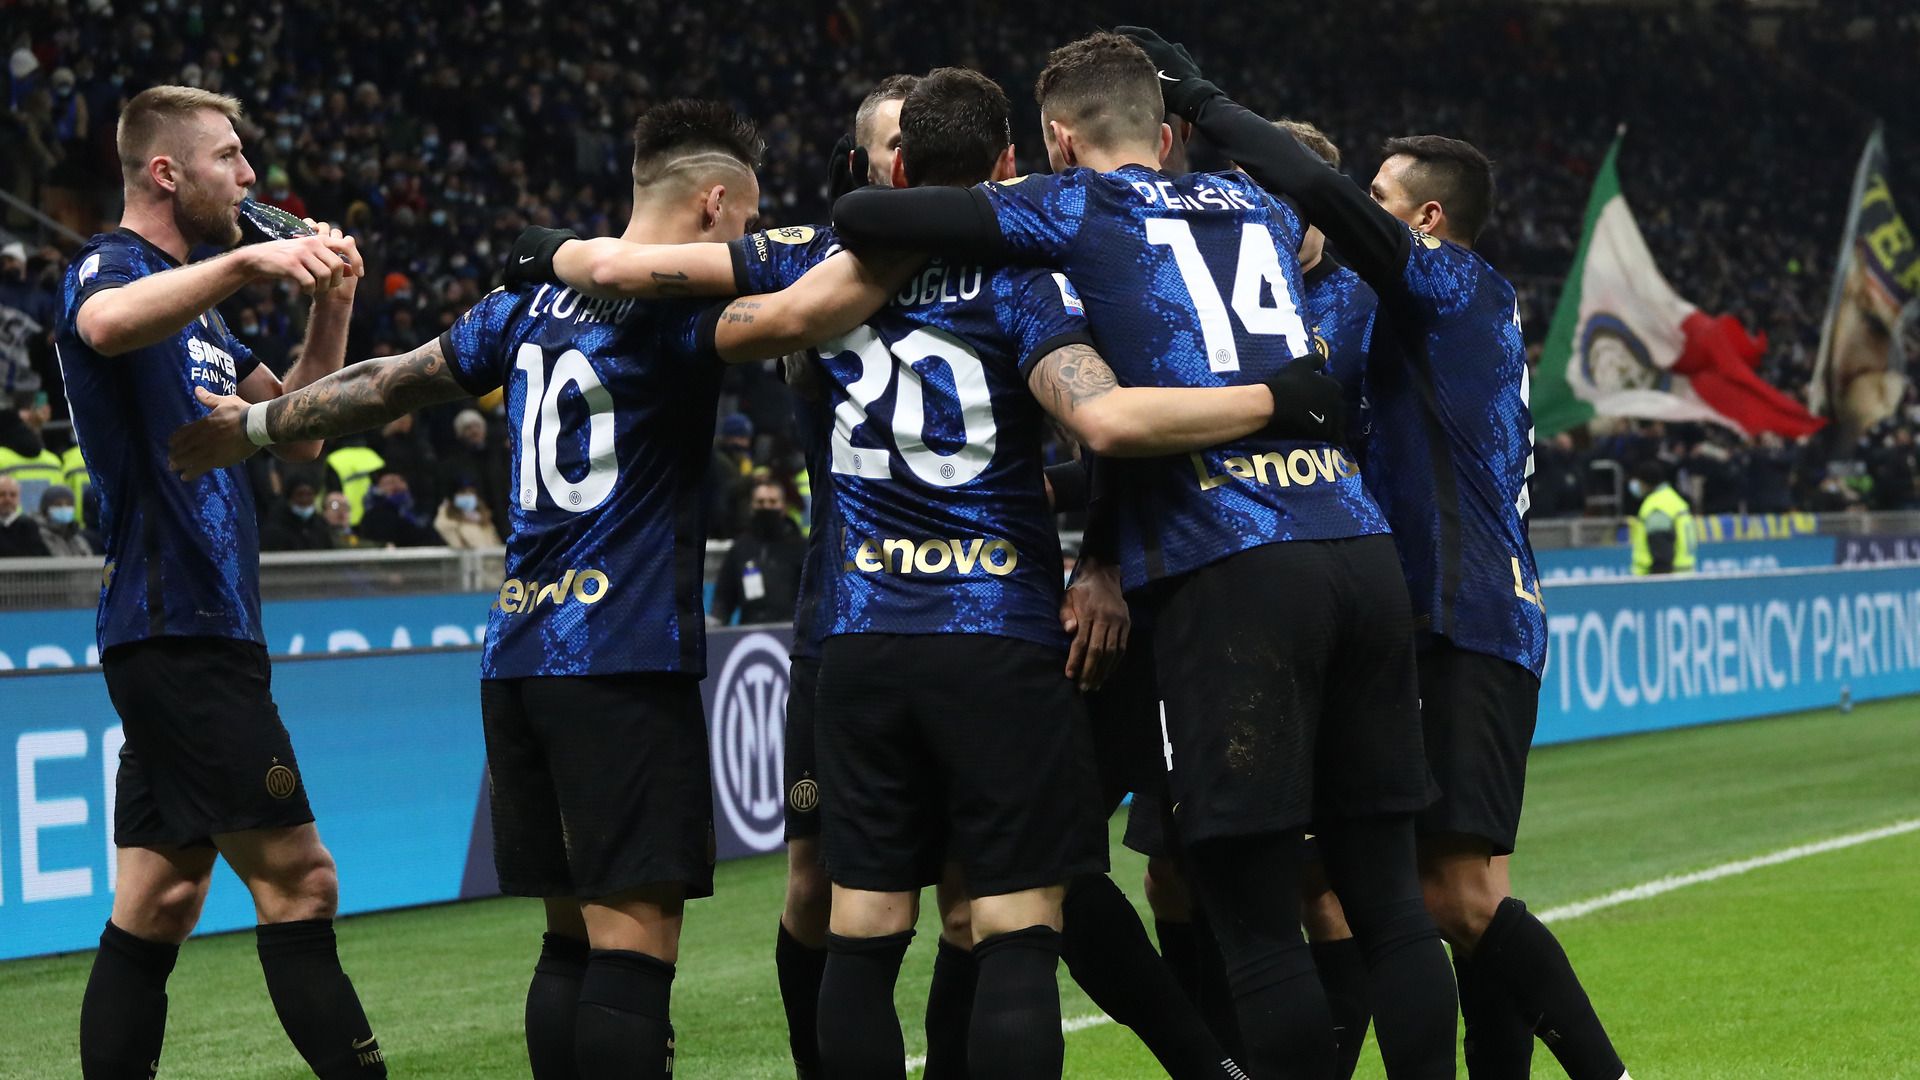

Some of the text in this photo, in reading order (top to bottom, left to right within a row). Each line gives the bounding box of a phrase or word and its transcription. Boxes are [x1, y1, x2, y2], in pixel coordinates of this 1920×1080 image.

[1146, 217, 1312, 373] 14
[191, 367, 219, 384] FAN
[516, 342, 619, 512] 10
[815, 324, 998, 487] 20
[1542, 589, 1920, 712] TOCURRENCY PARTN
